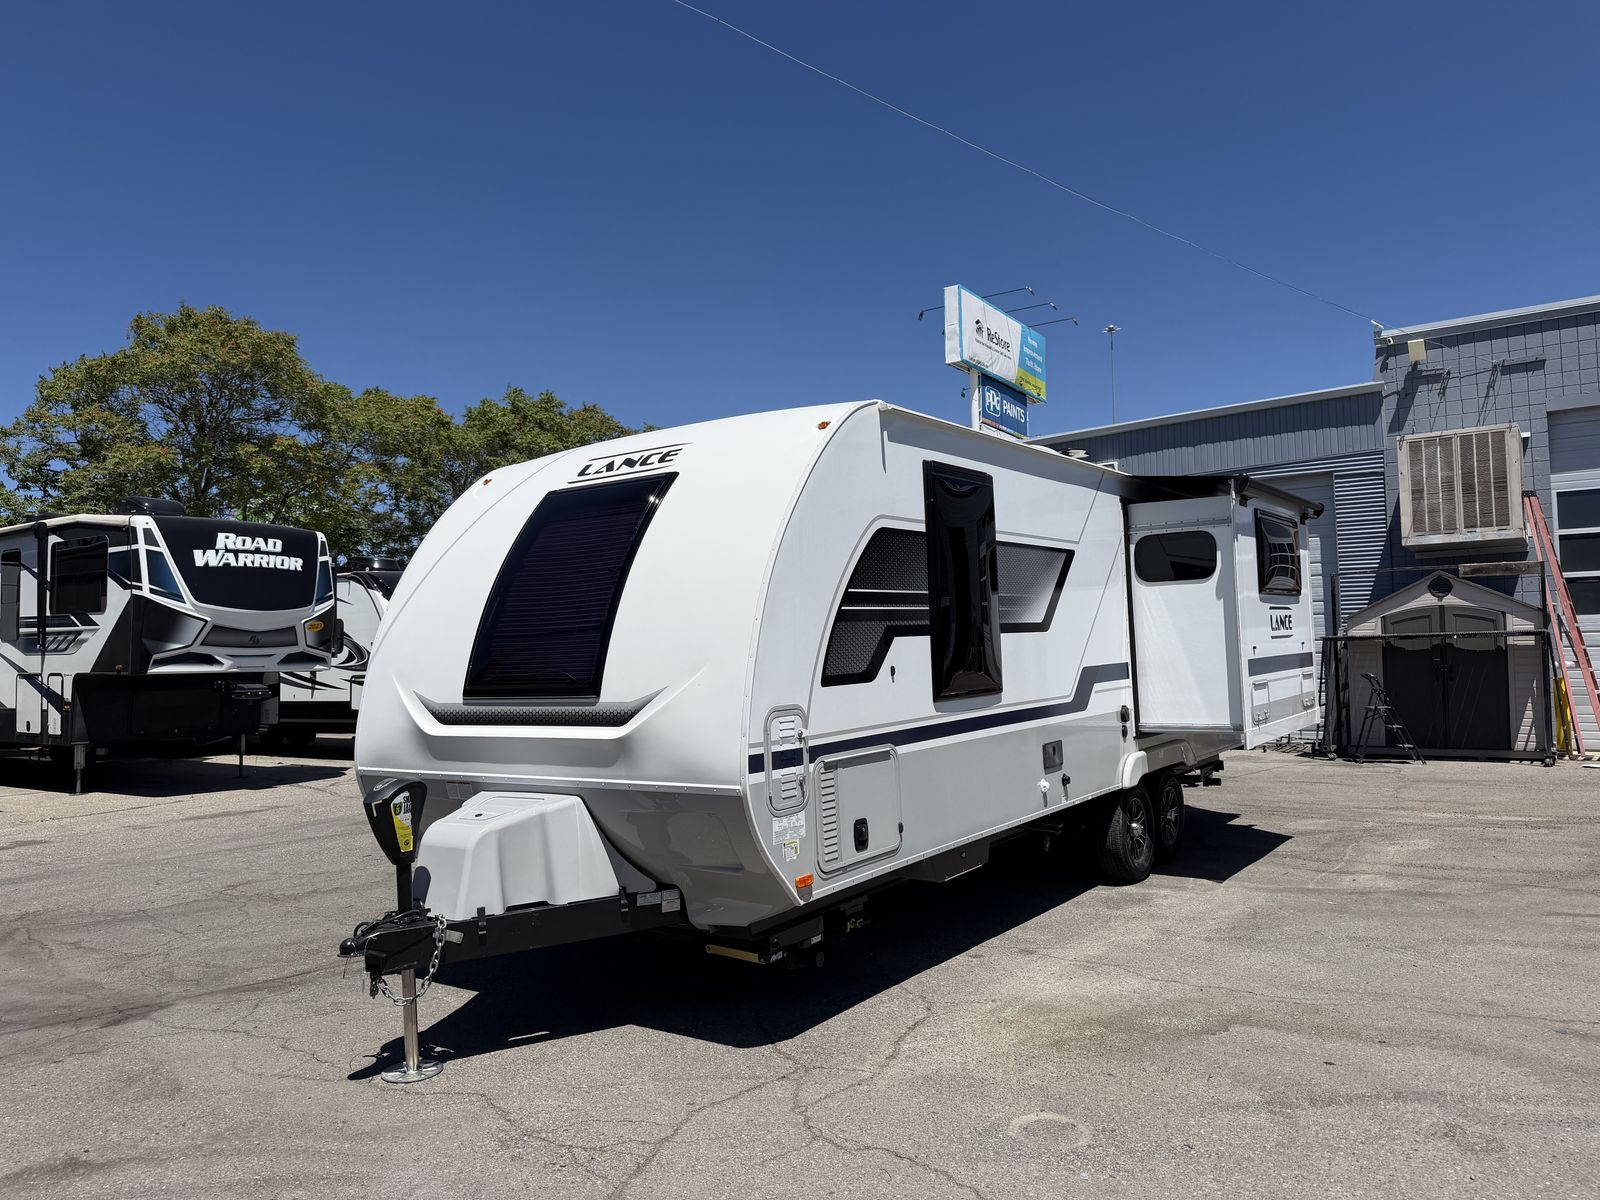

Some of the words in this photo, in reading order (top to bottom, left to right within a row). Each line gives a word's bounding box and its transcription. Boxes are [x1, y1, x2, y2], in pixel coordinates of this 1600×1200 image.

[987, 327, 1011, 352] ReStore
[985, 389, 1001, 412] PPG
[1003, 399, 1025, 423] PAINTS
[577, 448, 683, 477] LANCE
[215, 532, 283, 553] ROAD
[192, 549, 304, 572] WARRIOR
[1270, 614, 1293, 632] LANCE
